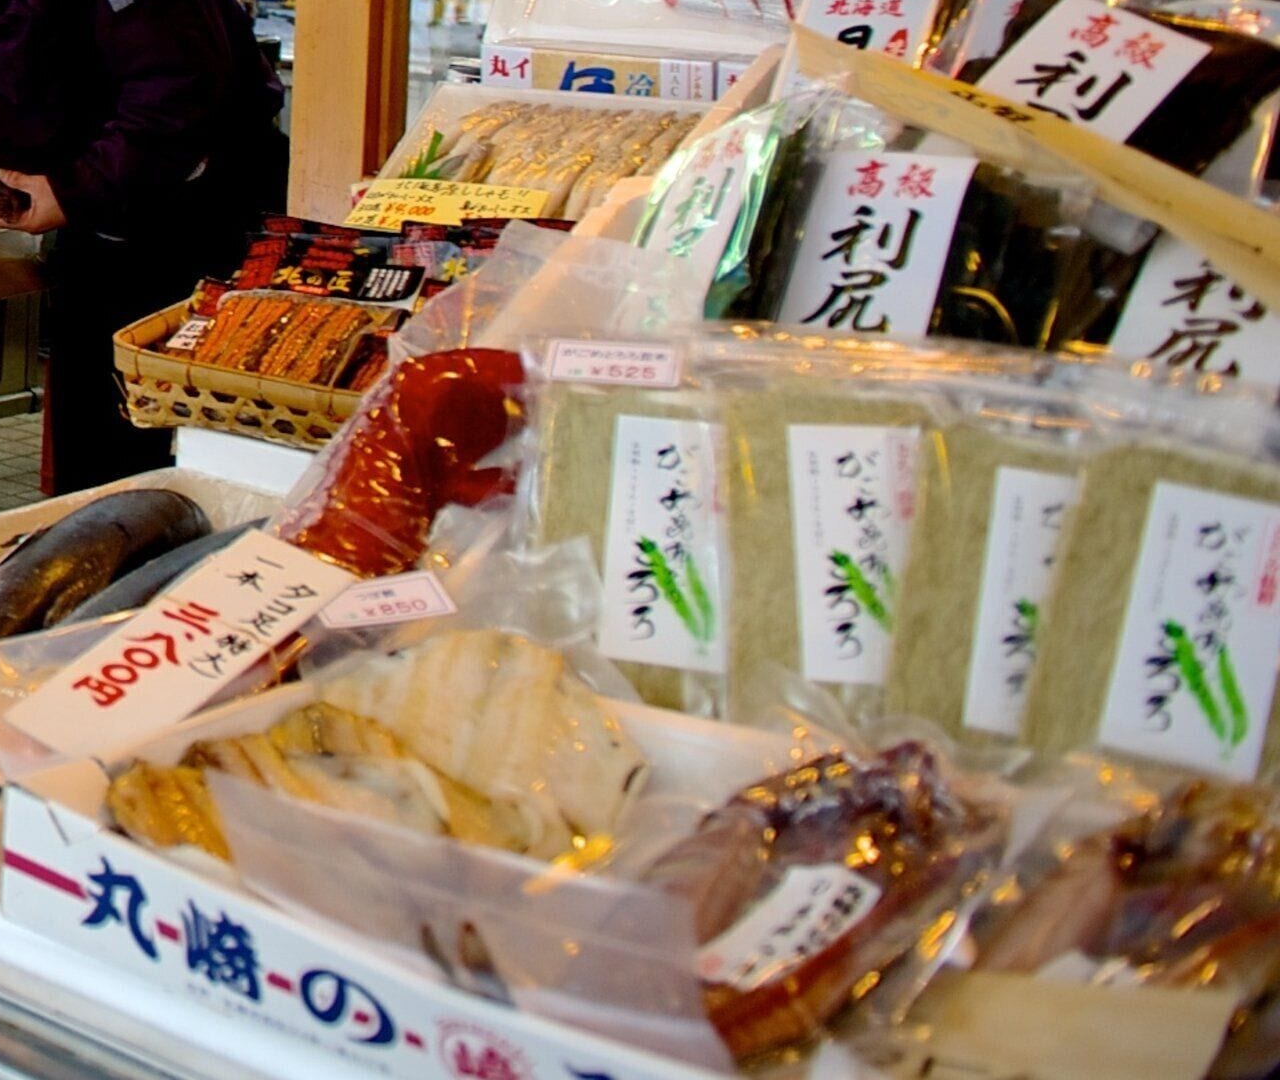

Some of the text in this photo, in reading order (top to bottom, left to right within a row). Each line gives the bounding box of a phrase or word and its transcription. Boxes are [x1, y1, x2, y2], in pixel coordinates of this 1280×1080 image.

[1069, 14, 1166, 70] 高級
[847, 159, 935, 199] 高級
[262, 266, 352, 293] 北の匠
[802, 206, 924, 333] 利尻
[590, 365, 657, 379] ¥525
[226, 553, 286, 595] 一本
[364, 599, 429, 618] ¥850
